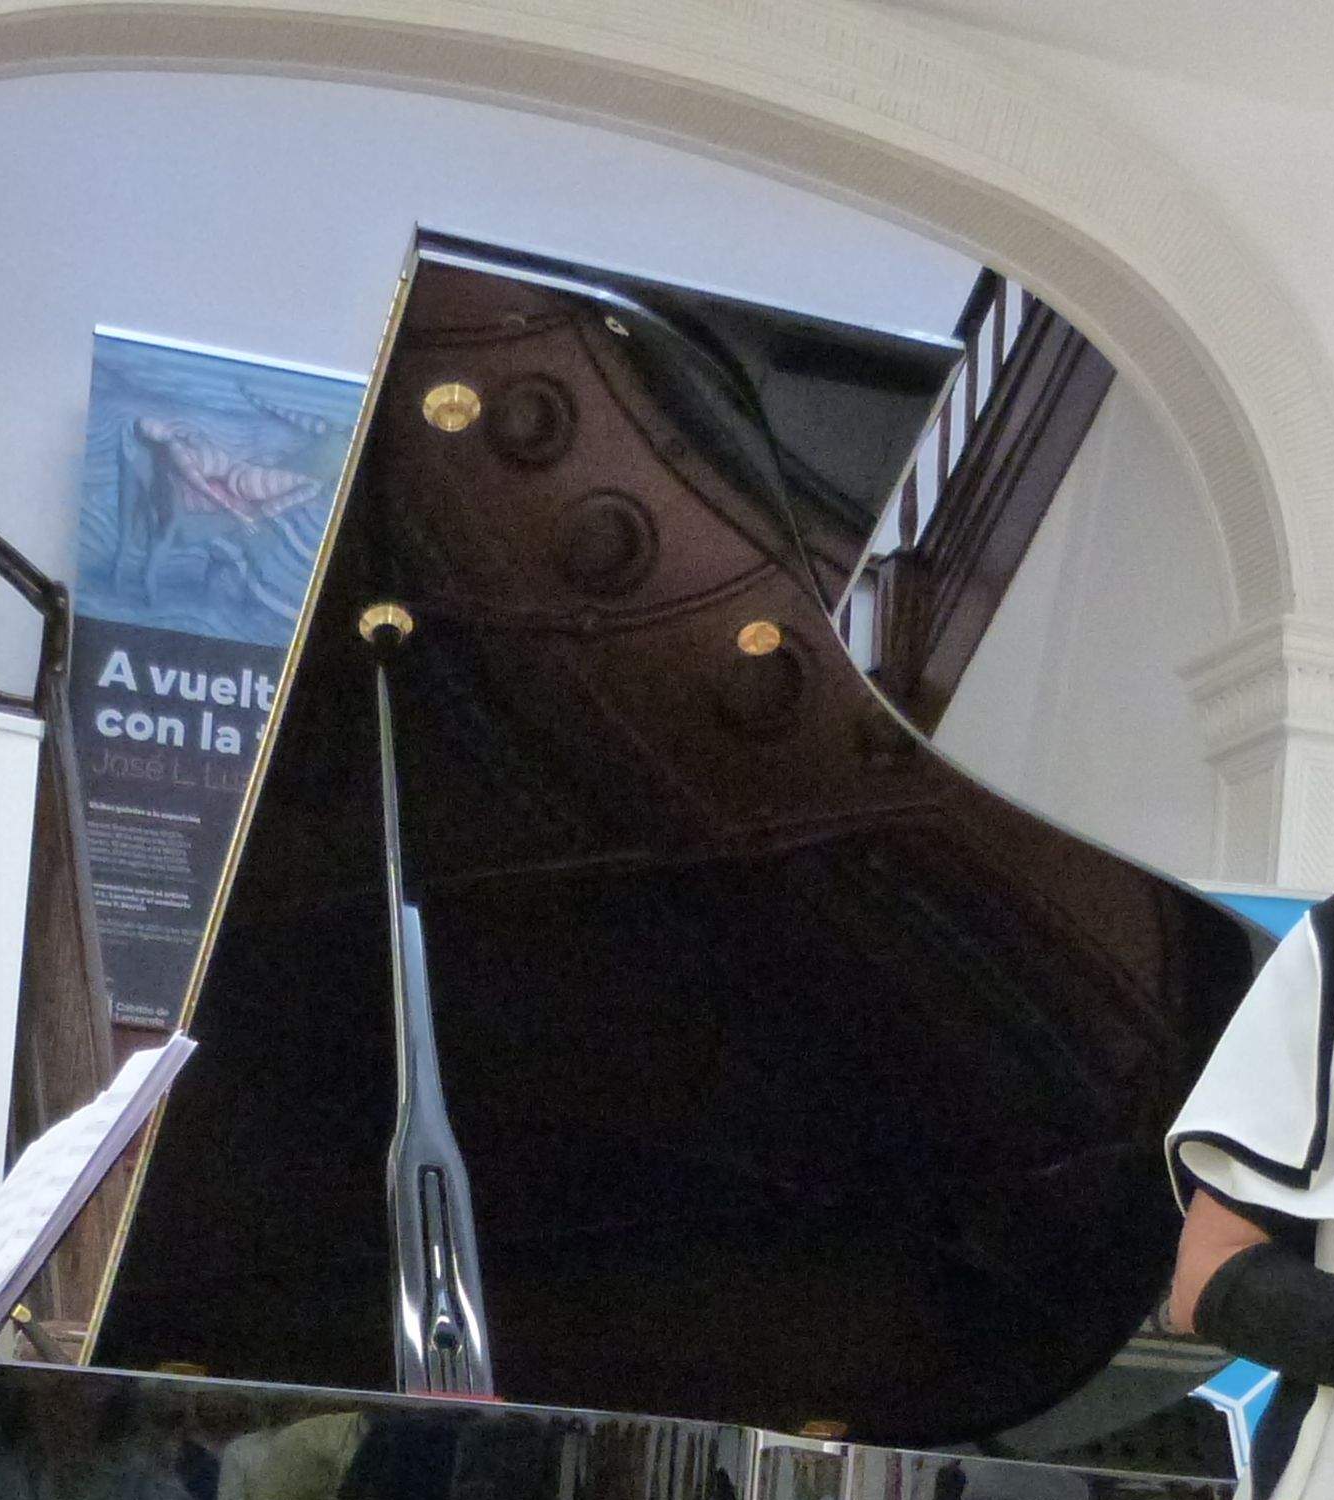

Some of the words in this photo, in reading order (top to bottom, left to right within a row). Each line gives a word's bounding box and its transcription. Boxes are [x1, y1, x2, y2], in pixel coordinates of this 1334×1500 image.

[98, 650, 137, 692] A
[149, 665, 277, 713] vuelt
[96, 707, 186, 748] con
[201, 711, 242, 755] la
